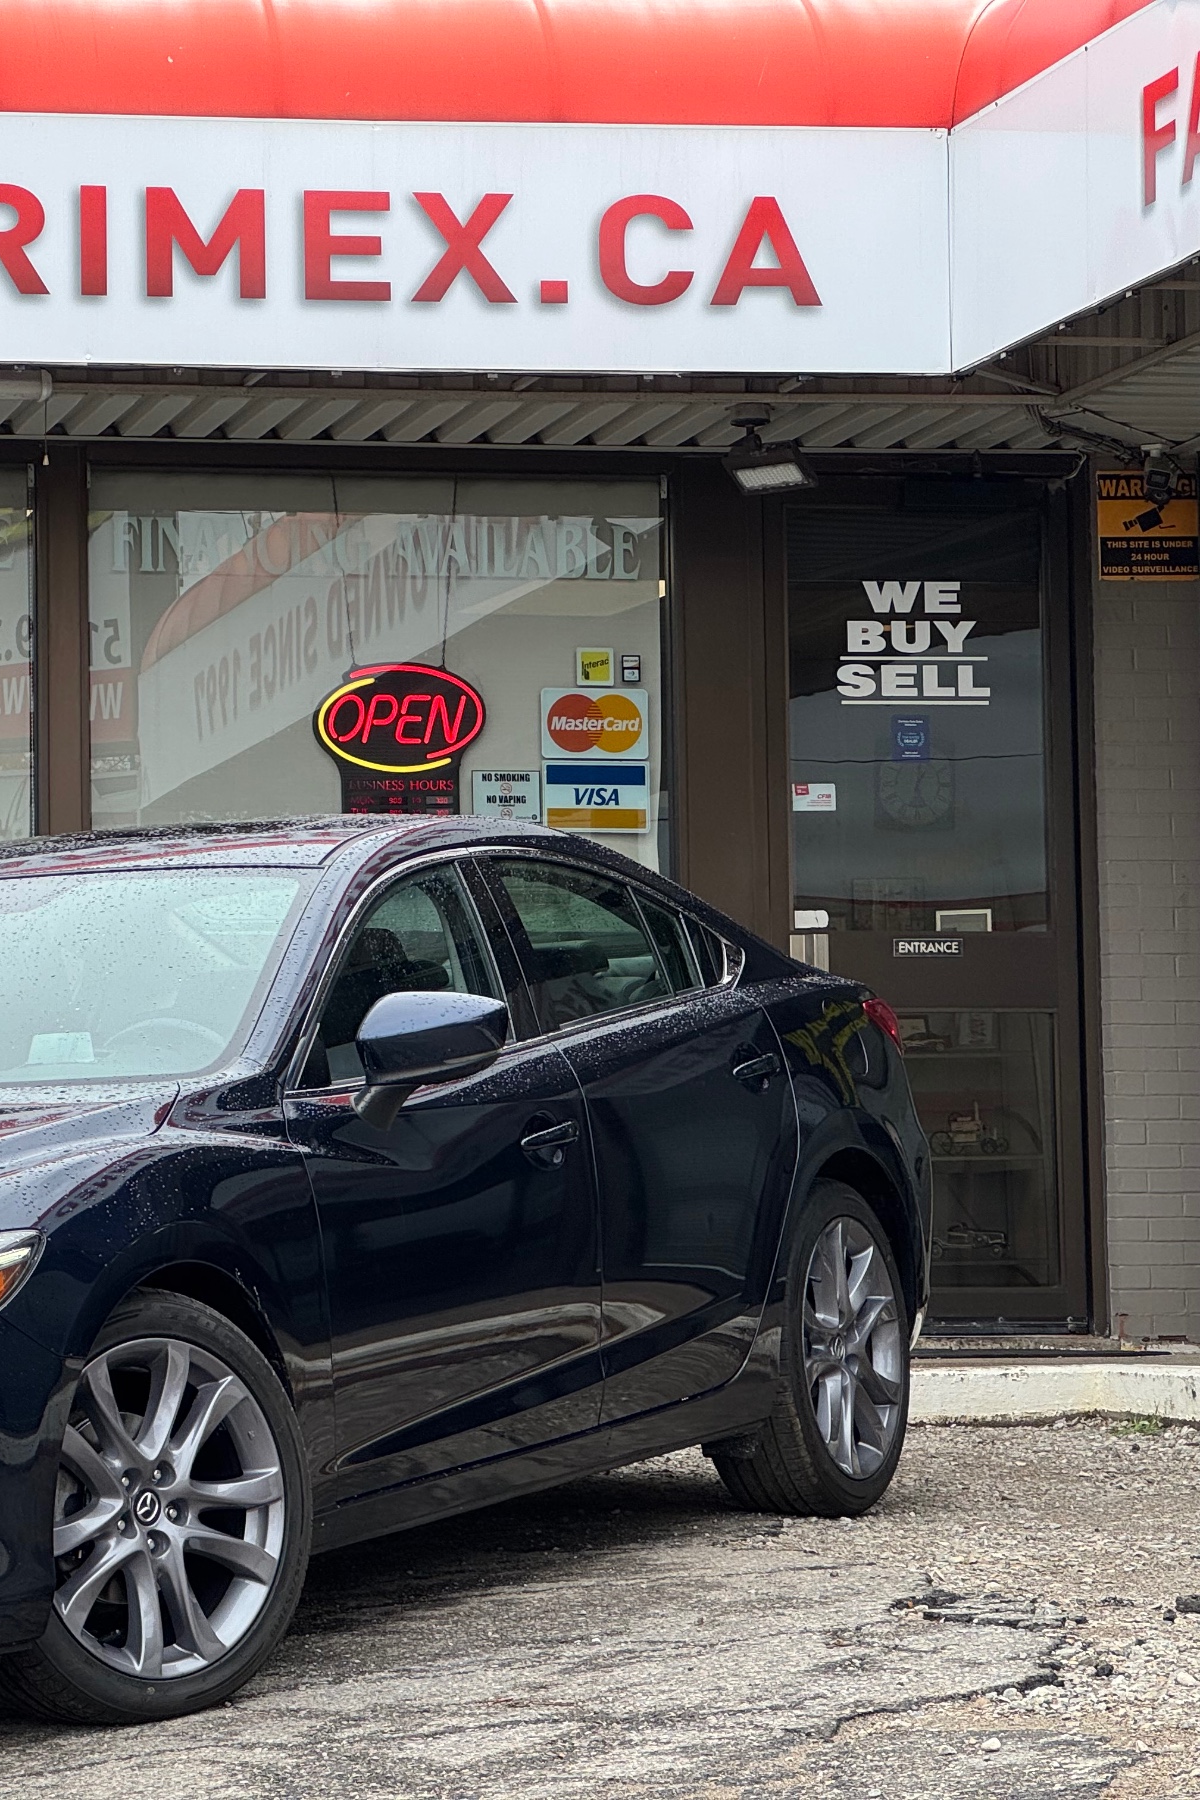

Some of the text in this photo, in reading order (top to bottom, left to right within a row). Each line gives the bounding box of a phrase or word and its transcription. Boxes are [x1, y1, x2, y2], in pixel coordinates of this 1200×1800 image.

[1099, 479, 1196, 497] WARG!
[110, 515, 371, 576] FINANCING
[388, 522, 642, 581] AVAILABLE
[1106, 540, 1194, 549] THIS SITE IS UNDER
[1130, 553, 1170, 561] 24 HOUR
[1102, 565, 1199, 574] VIDEO SURVEILLANCE
[861, 580, 962, 614] WE
[846, 620, 977, 653] BUY
[581, 658, 610, 670] Interac
[836, 664, 992, 698] SELL
[327, 693, 468, 745] OPEN
[551, 716, 640, 732] MasterCard
[348, 779, 455, 791] BUSINESS HOURS
[481, 773, 531, 783] NO SMOKING
[486, 795, 527, 804] NO VAPING
[573, 787, 620, 806] VISA
[898, 941, 960, 954] ENTRANCE
